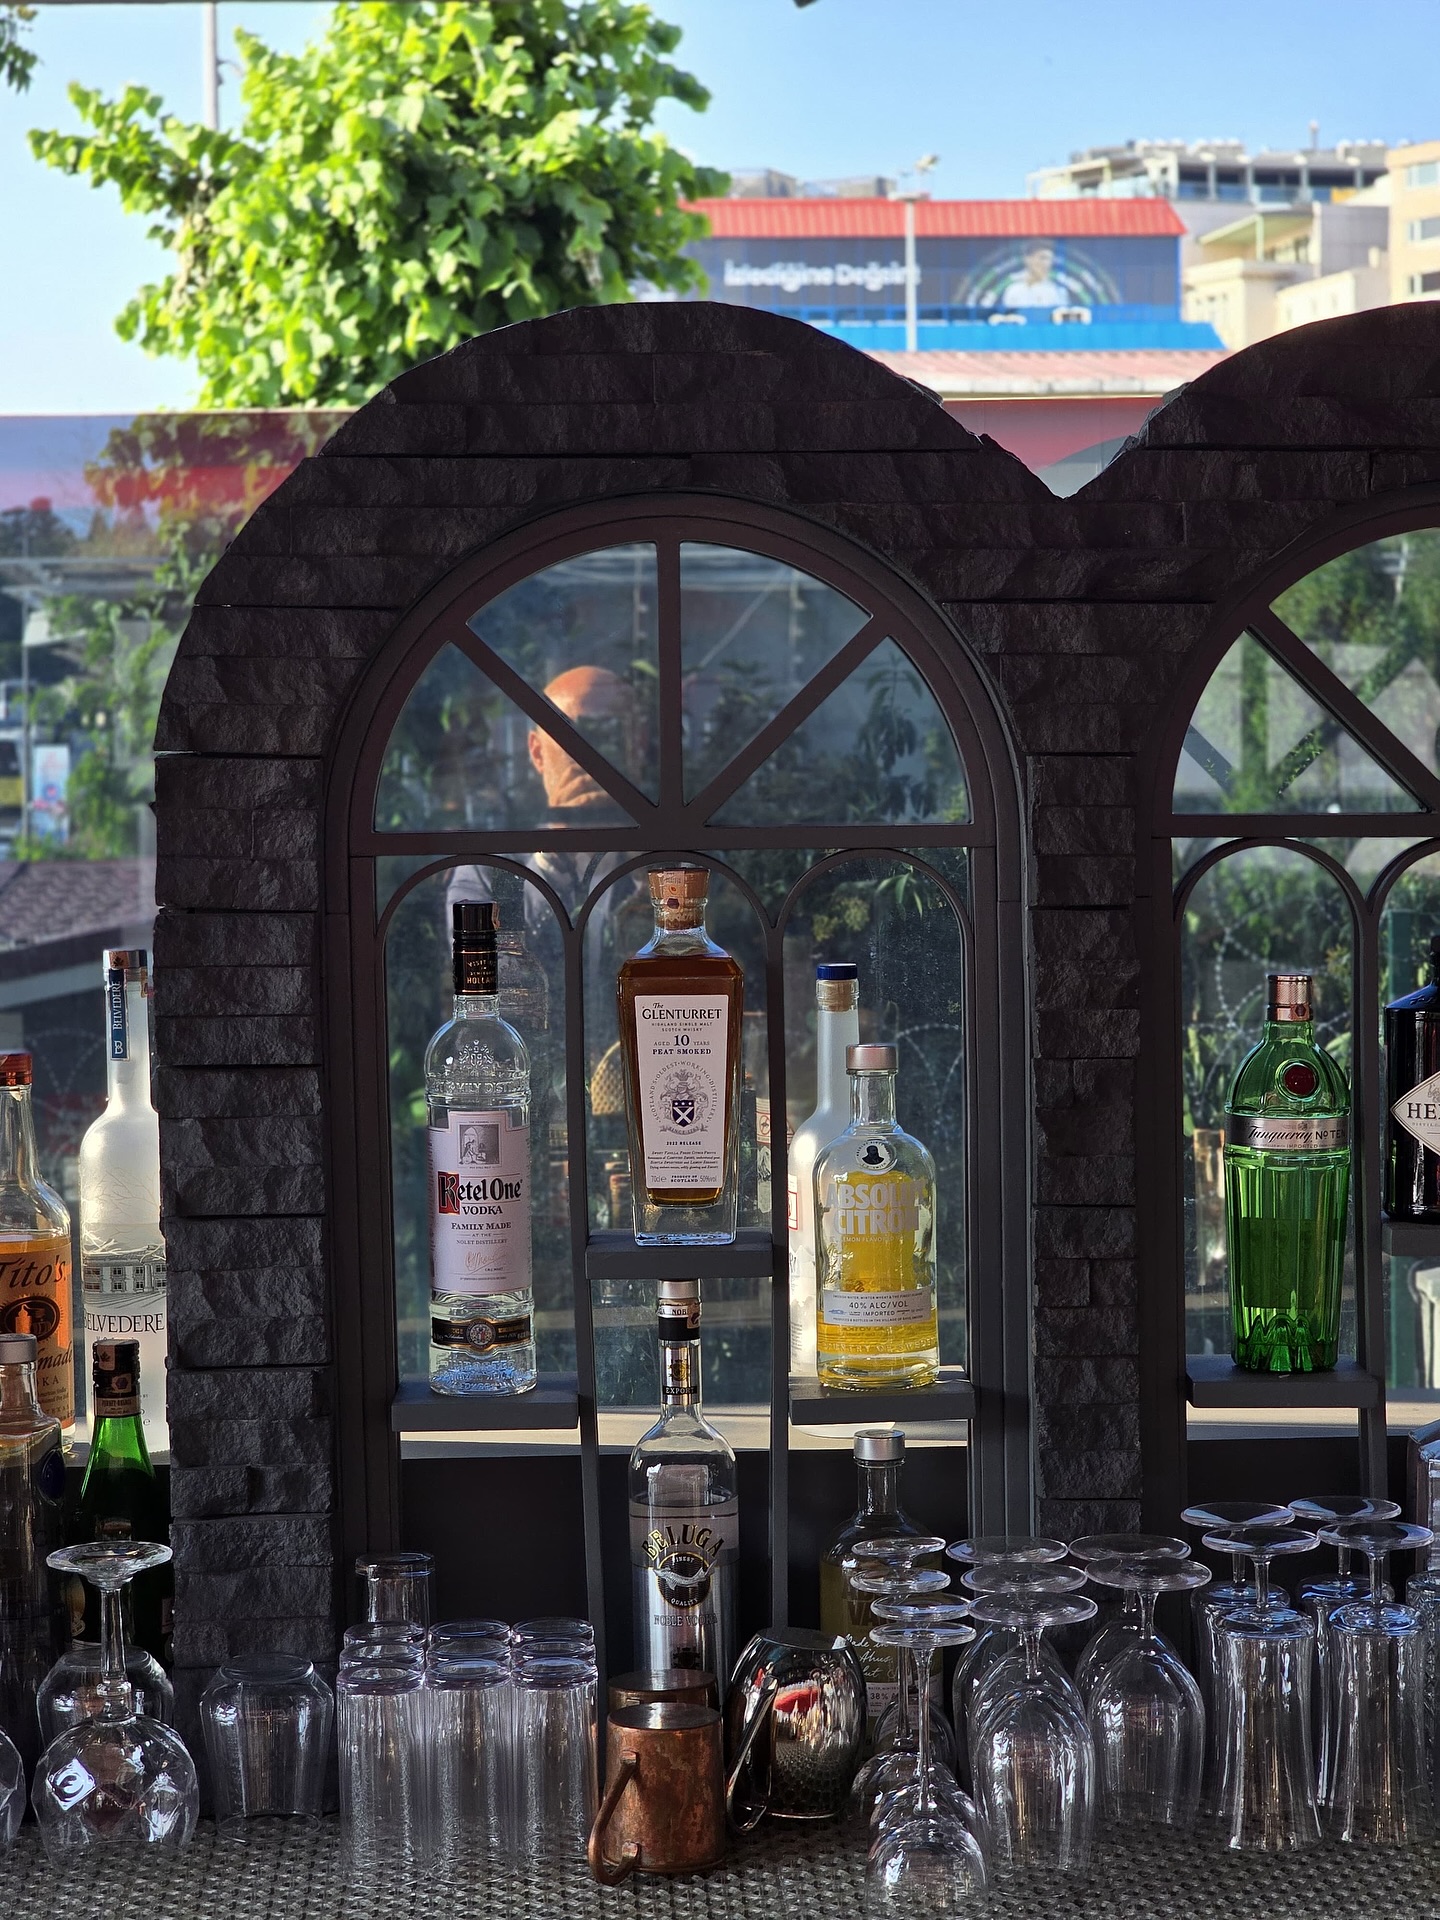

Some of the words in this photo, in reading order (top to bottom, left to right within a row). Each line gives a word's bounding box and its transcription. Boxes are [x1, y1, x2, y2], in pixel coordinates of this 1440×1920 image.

[112, 980, 123, 1031] BELVEDERE
[642, 1008, 722, 1020] GLENTURRET
[674, 1034, 690, 1047] 10
[1406, 1102, 1440, 1119] HE
[1247, 1125, 1313, 1143] Tanqueray
[1329, 1129, 1346, 1139] TEN
[439, 1175, 489, 1211] Ketel
[490, 1178, 522, 1200] One
[462, 1205, 503, 1215] VODKA
[451, 1222, 485, 1230] FAMILY
[486, 1222, 512, 1230] MADE
[834, 1206, 920, 1235] CITRON
[849, 1302, 867, 1310] 40%
[869, 1300, 909, 1309] ALC/VOL
[671, 1308, 687, 1316] NOB
[665, 1386, 694, 1394] EXPORT
[641, 1523, 725, 1560] BELUGA
[670, 1598, 699, 1607] QUALITY
[654, 1614, 683, 1626] NOBLE
